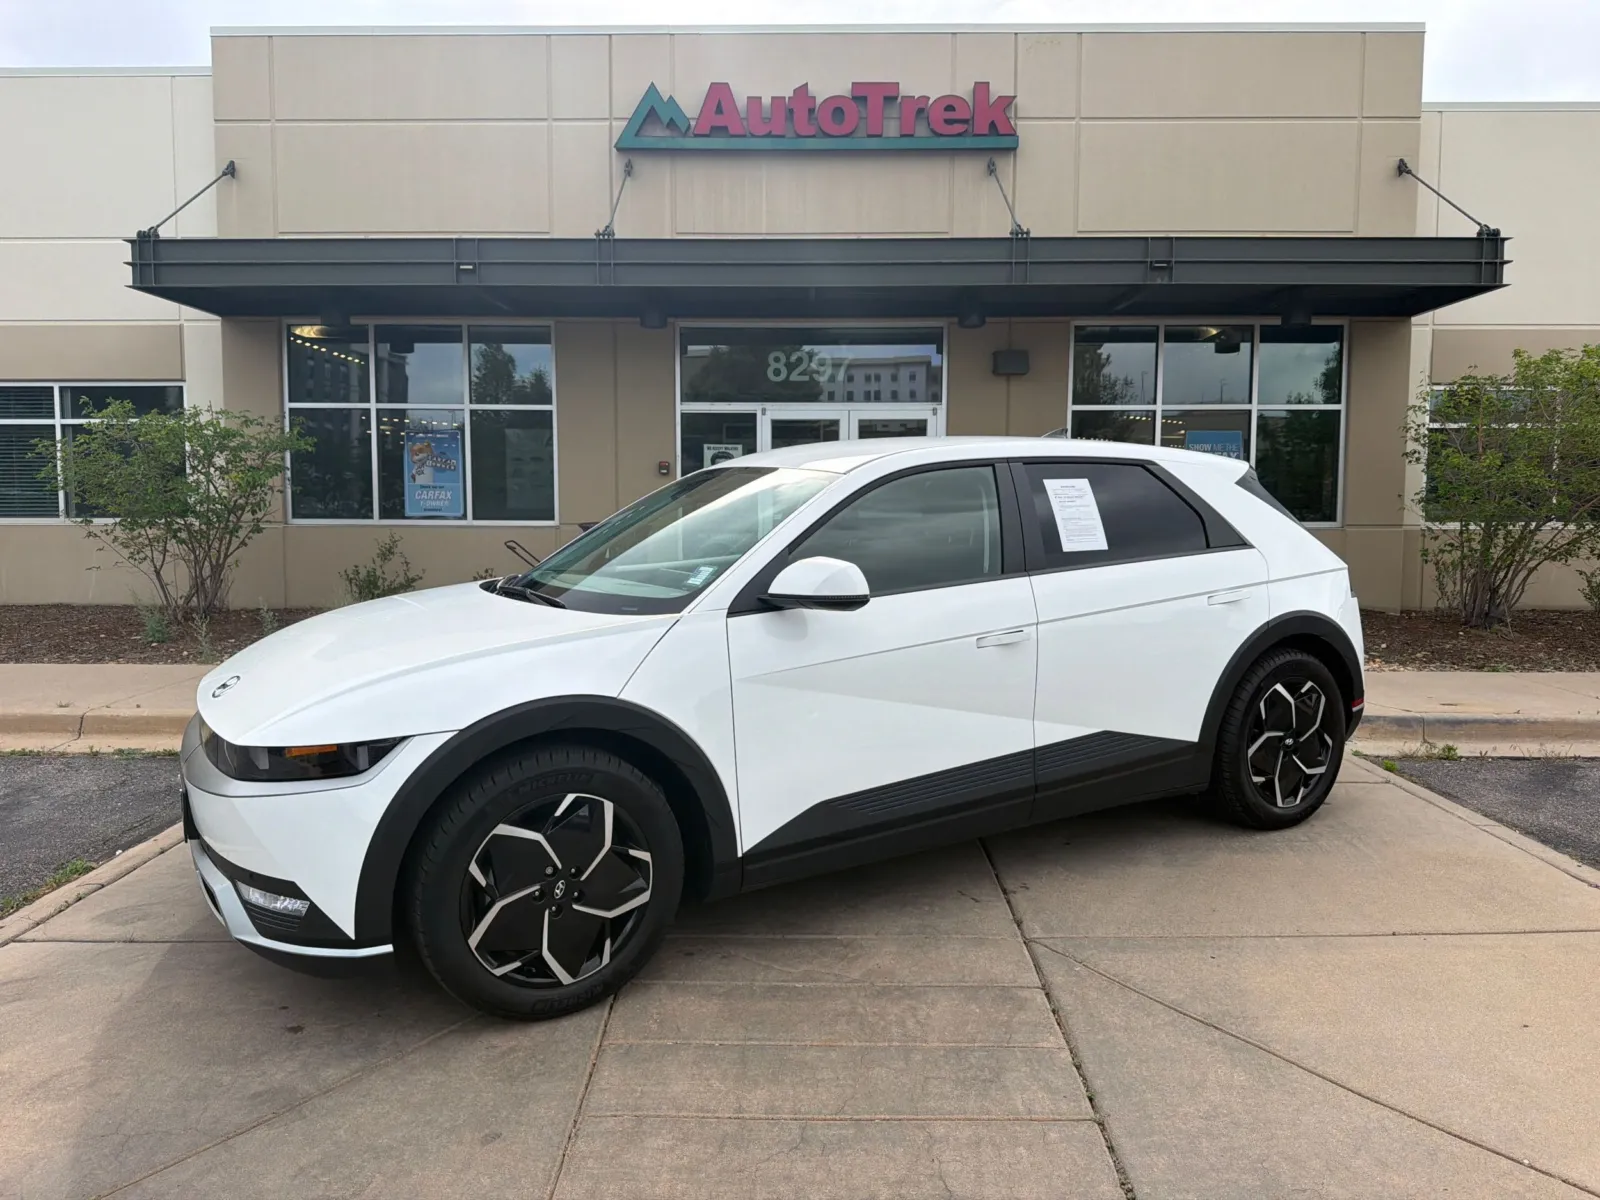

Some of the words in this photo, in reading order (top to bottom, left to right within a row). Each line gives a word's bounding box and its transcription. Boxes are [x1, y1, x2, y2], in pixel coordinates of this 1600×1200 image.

[693, 81, 1018, 137] AutoTrek
[766, 351, 854, 382] 8297
[1189, 443, 1212, 451] SHOW
[1213, 443, 1224, 451] ME
[1226, 443, 1239, 451] THE
[415, 490, 452, 500] CARFAX
